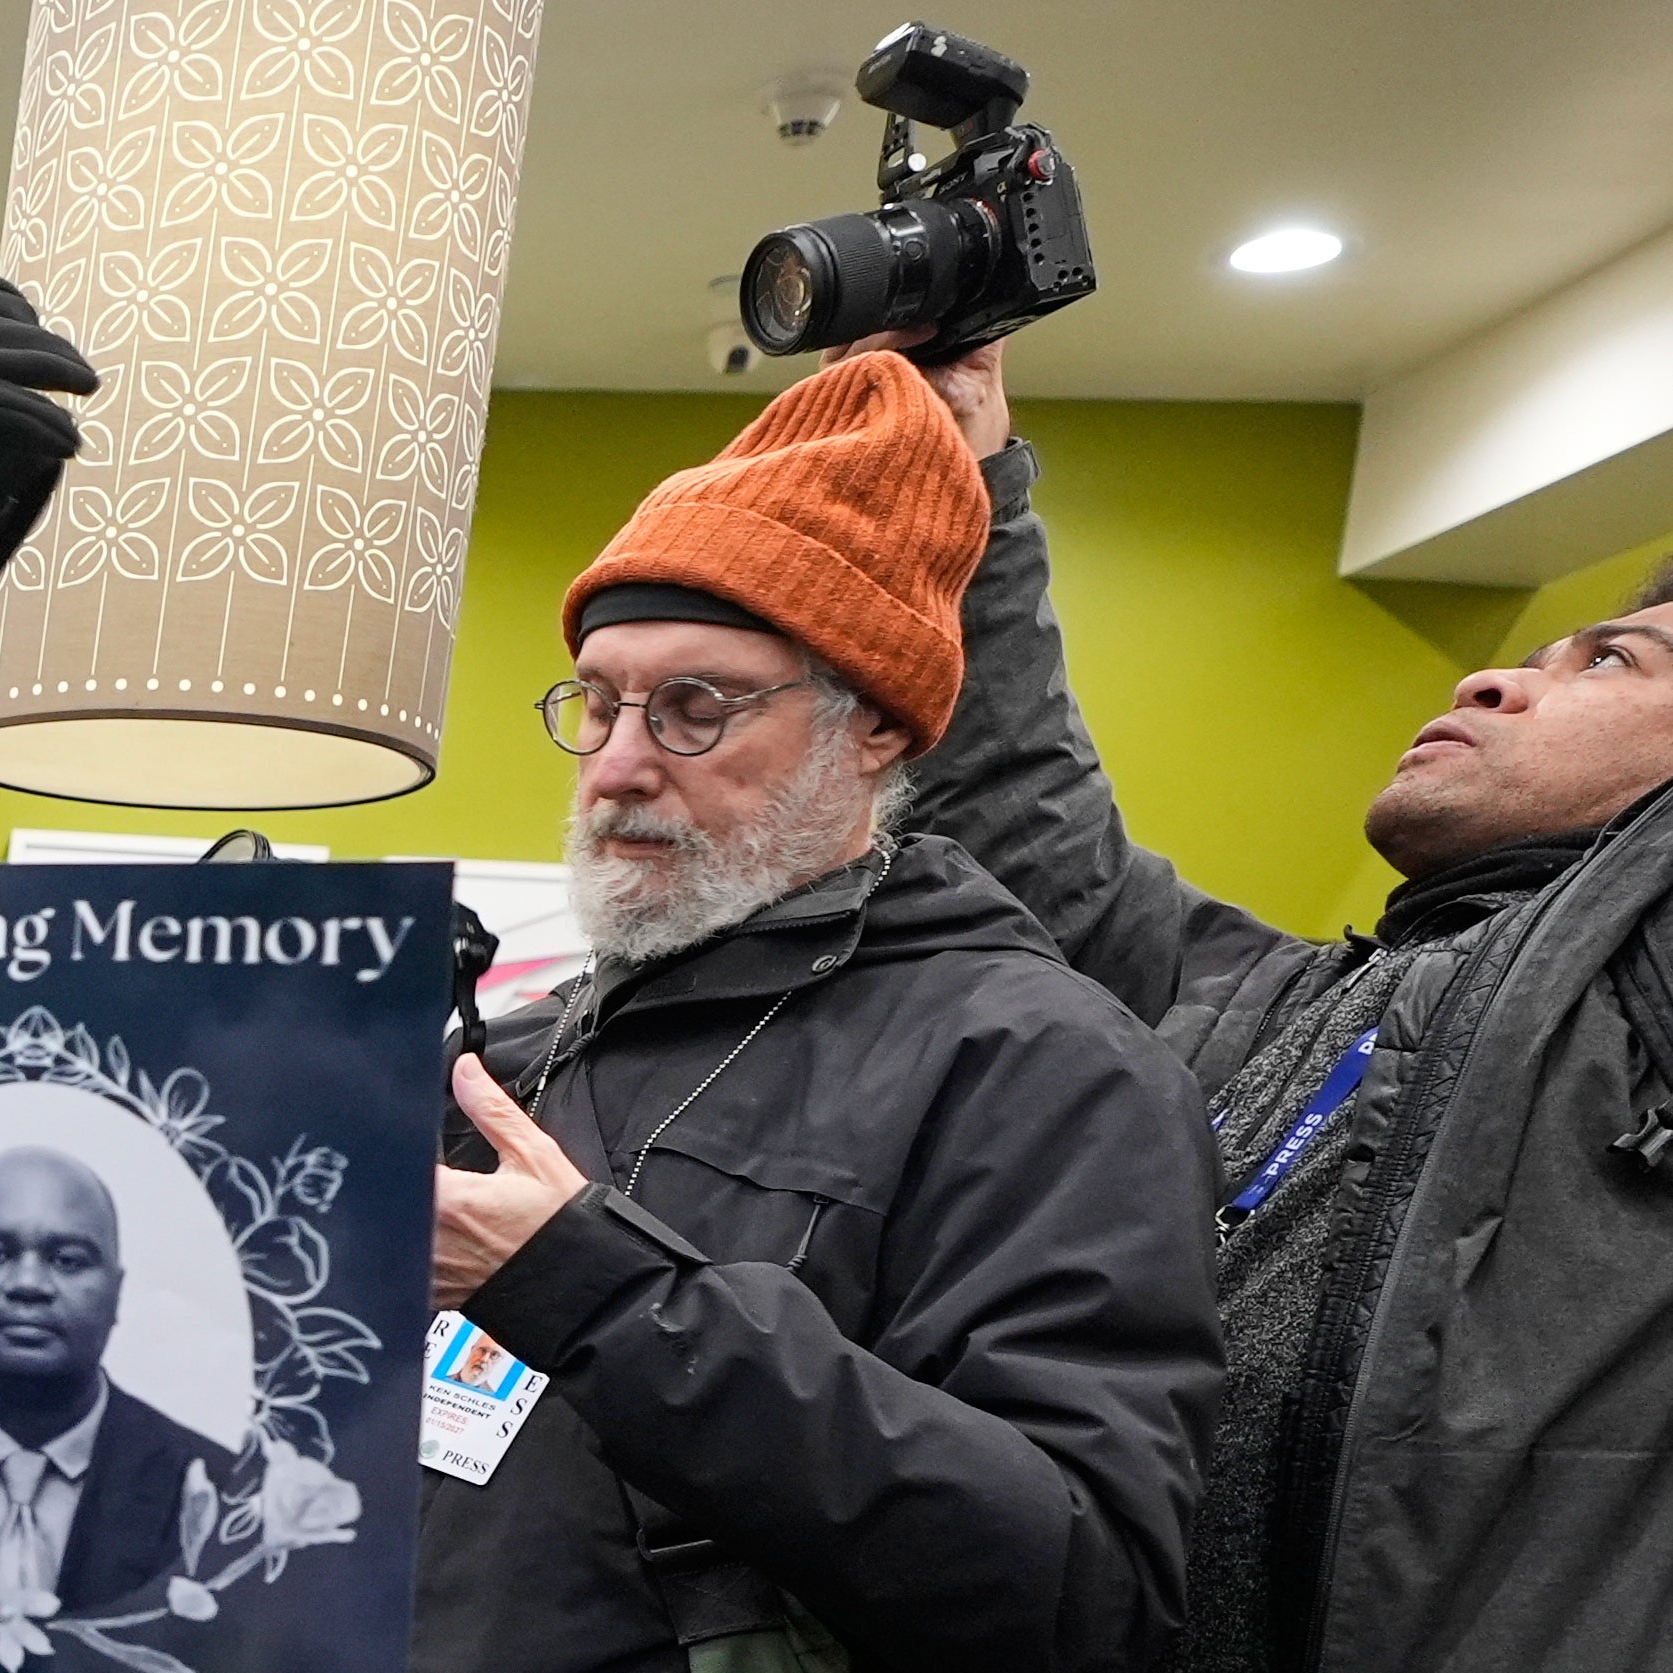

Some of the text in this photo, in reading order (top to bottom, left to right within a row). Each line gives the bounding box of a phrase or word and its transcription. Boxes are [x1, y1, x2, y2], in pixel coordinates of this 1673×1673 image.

[72, 899, 414, 985] Memory
[1264, 1112, 1324, 1177] PRESS
[429, 1385, 451, 1397] KEN
[422, 1393, 492, 1420] INDEPENDENT
[442, 1449, 491, 1476] PRESS
